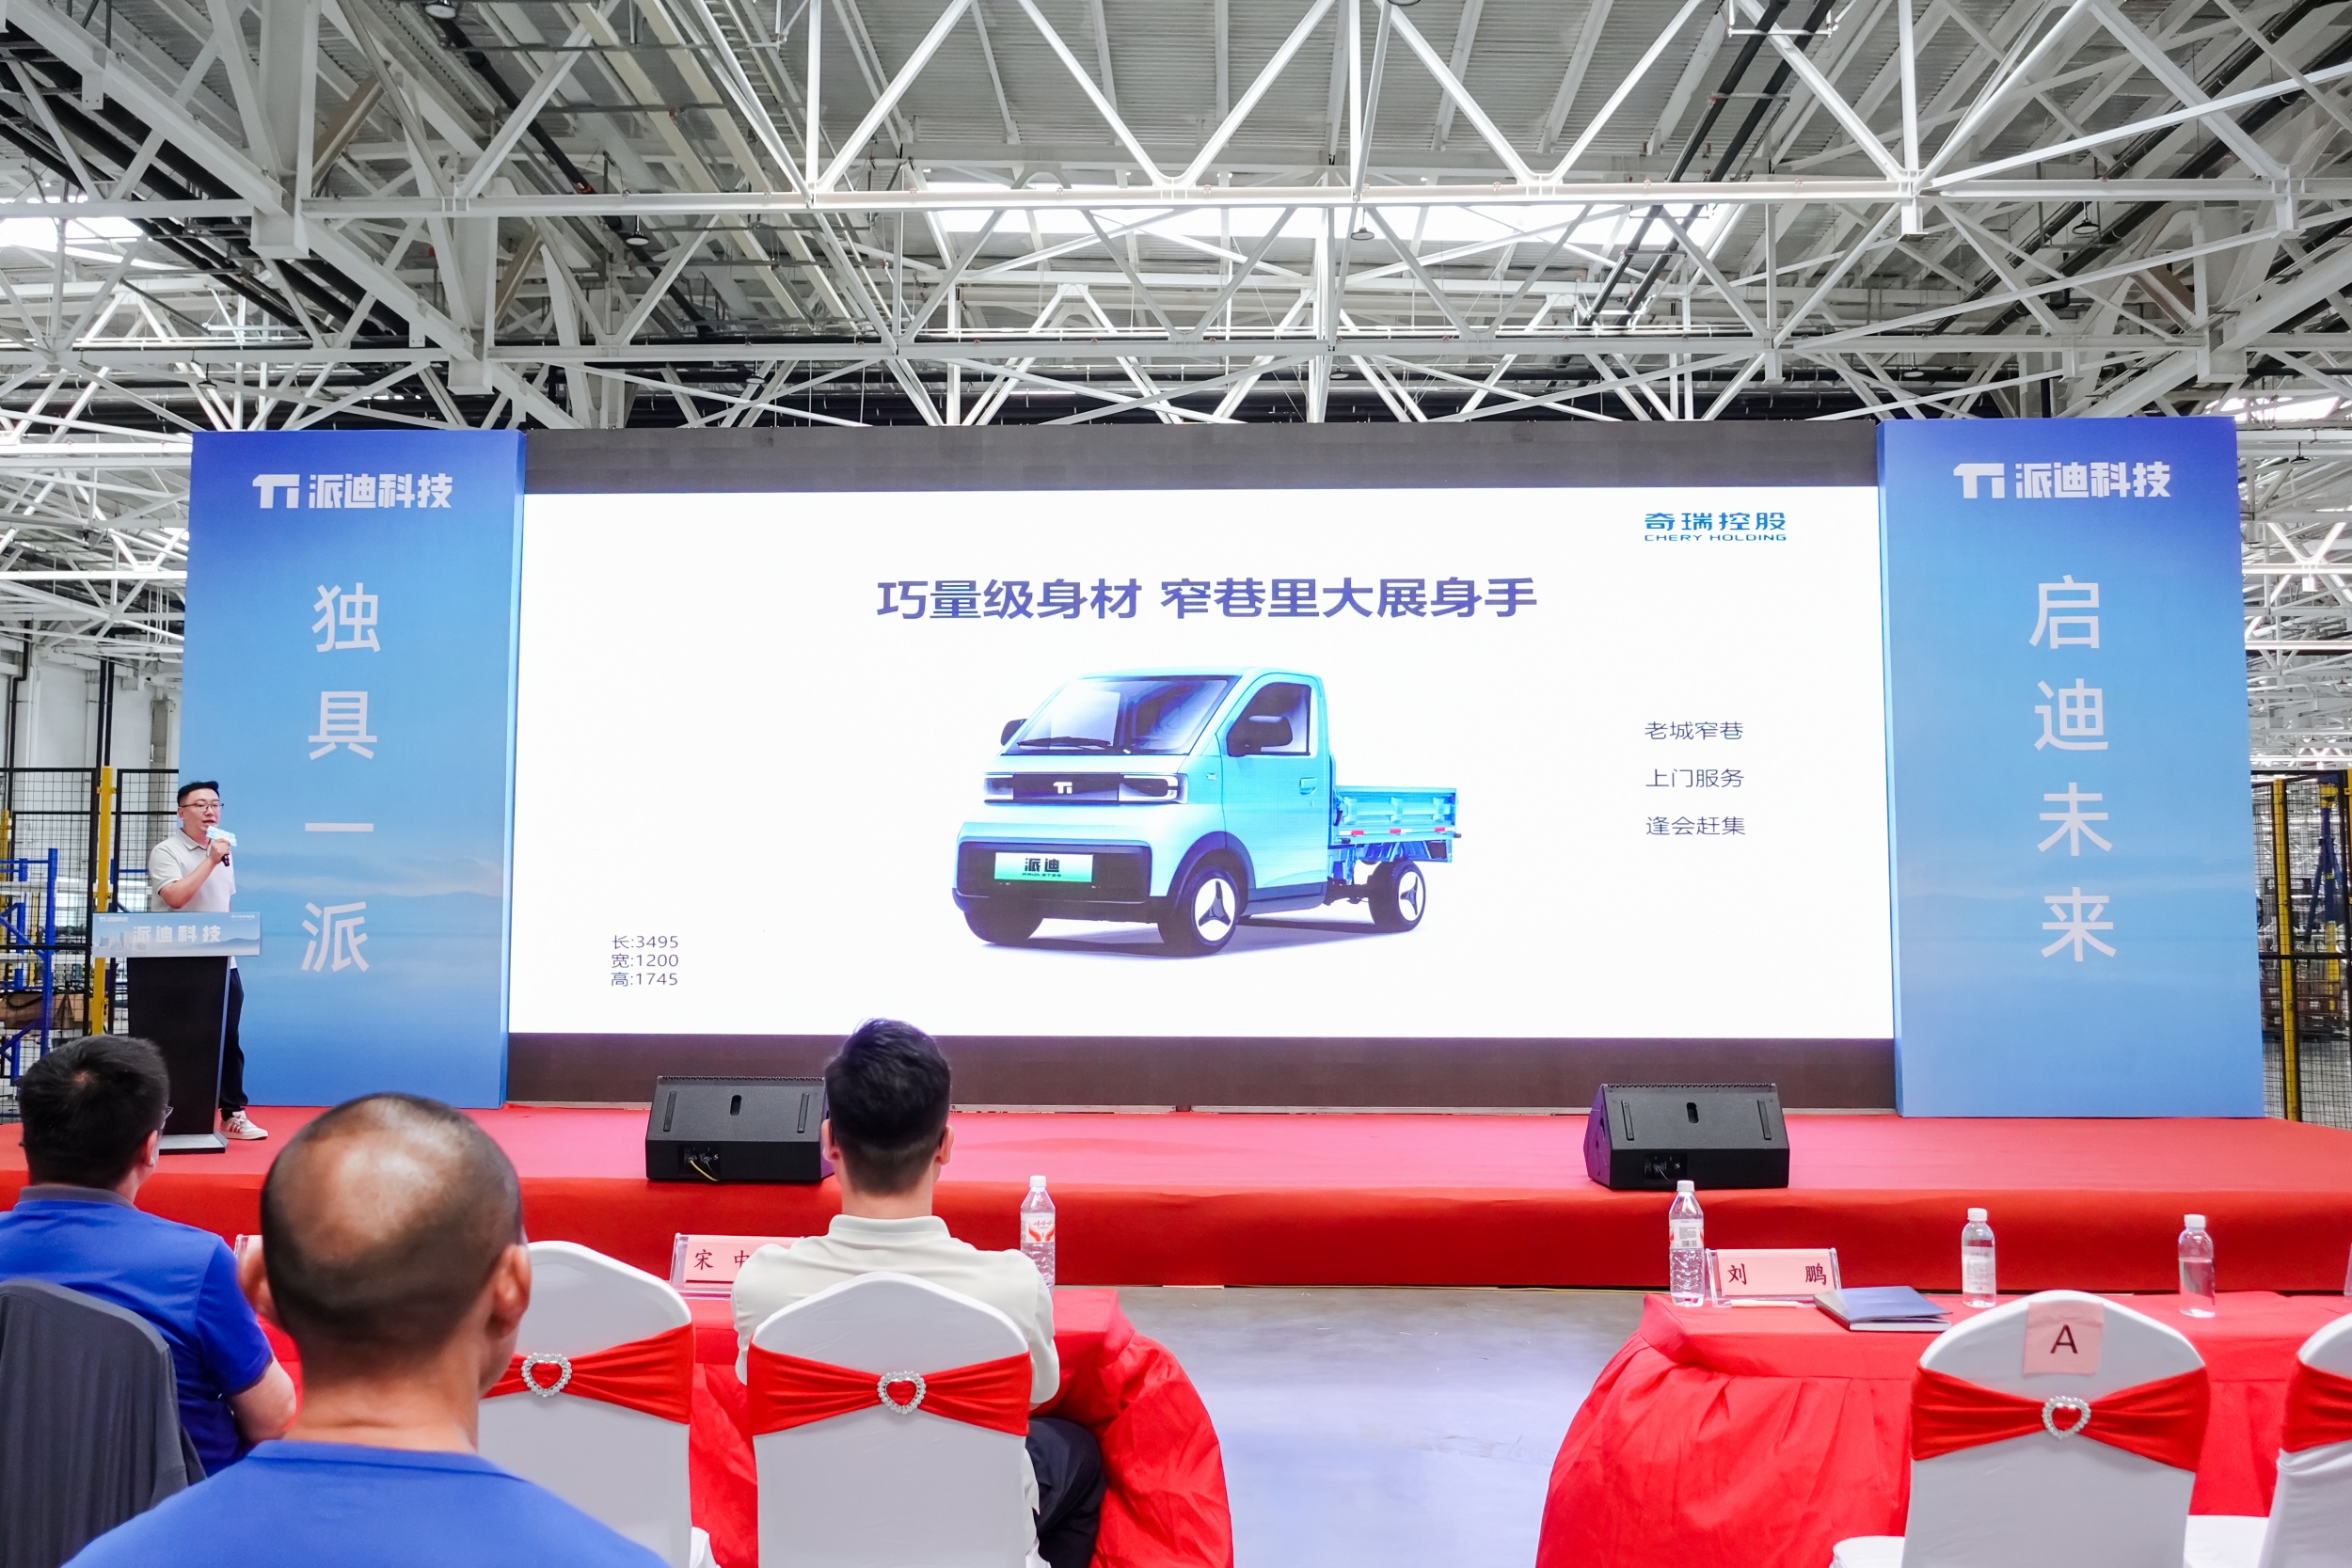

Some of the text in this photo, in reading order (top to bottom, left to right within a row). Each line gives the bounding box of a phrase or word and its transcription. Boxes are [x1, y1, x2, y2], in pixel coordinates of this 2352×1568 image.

[2015, 461, 2171, 499] 派迪科技
[309, 473, 453, 509] 派迪科技
[1644, 512, 1787, 531] 奇瑞控股
[1645, 533, 1788, 542] CHERY HOLDING
[876, 577, 1537, 620] 巧量级身材 窄巷里大展身手
[1645, 721, 1744, 741] 老城窄巷
[301, 582, 381, 973] 独具一派
[1645, 768, 1745, 788] 上门服务
[2028, 575, 2117, 962] 启迪未来
[1645, 816, 1746, 835] 逢会赶集
[1024, 858, 1060, 873] 派迪
[133, 925, 222, 943] 派迪科技
[612, 934, 678, 950] 长:3495
[611, 953, 679, 969] 宽:1200
[611, 972, 678, 987] 高:1745
[2050, 1323, 2078, 1354] A
